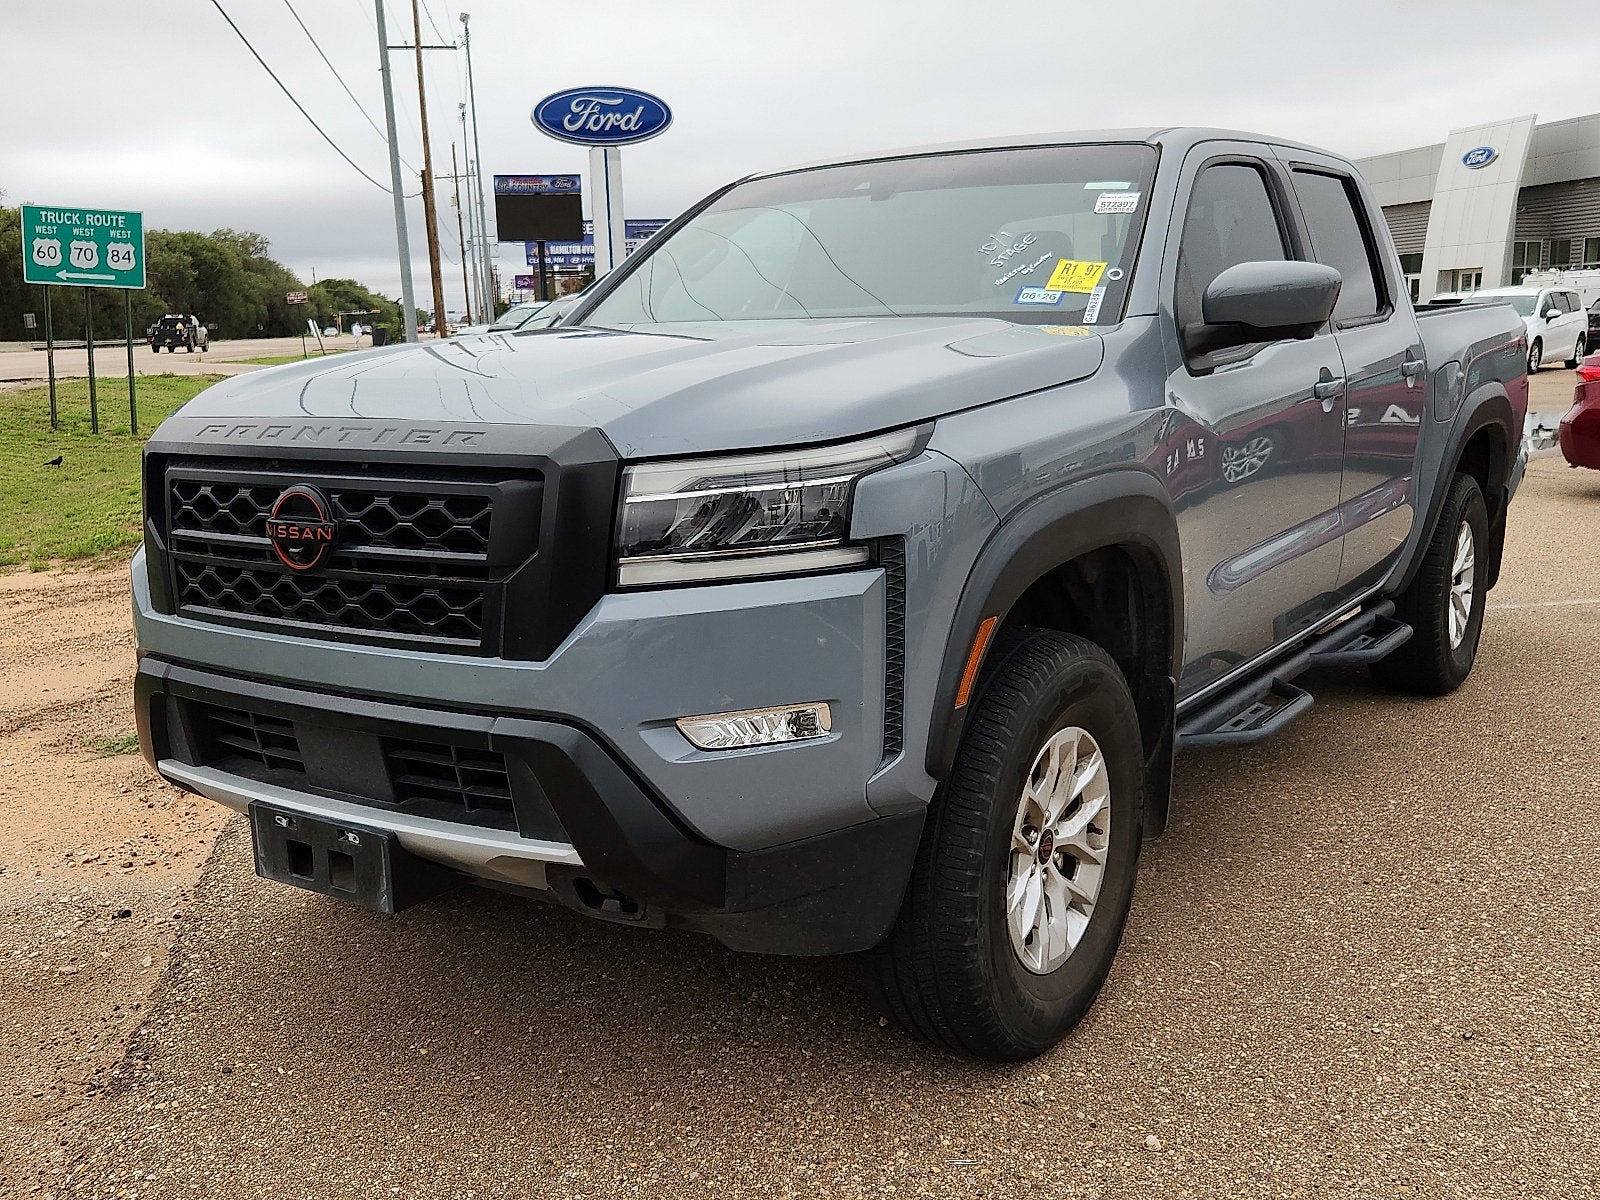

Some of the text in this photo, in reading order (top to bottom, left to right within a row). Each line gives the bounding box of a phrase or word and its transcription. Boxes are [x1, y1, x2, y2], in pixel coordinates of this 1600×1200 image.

[564, 97, 646, 132] Ford
[512, 184, 549, 192] COUNTRY
[555, 178, 572, 188] Ford
[40, 211, 126, 227] TRUCK ROUTE
[35, 225, 132, 239] WEST WEST WEST
[36, 245, 131, 264] 60 70 84
[550, 245, 581, 254] HAMILTON
[990, 233, 1038, 268] STAGE
[1060, 263, 1102, 276] R1 97
[1021, 292, 1037, 300] 06
[195, 424, 488, 447] FRONTIER
[265, 521, 333, 541] NISSAN
